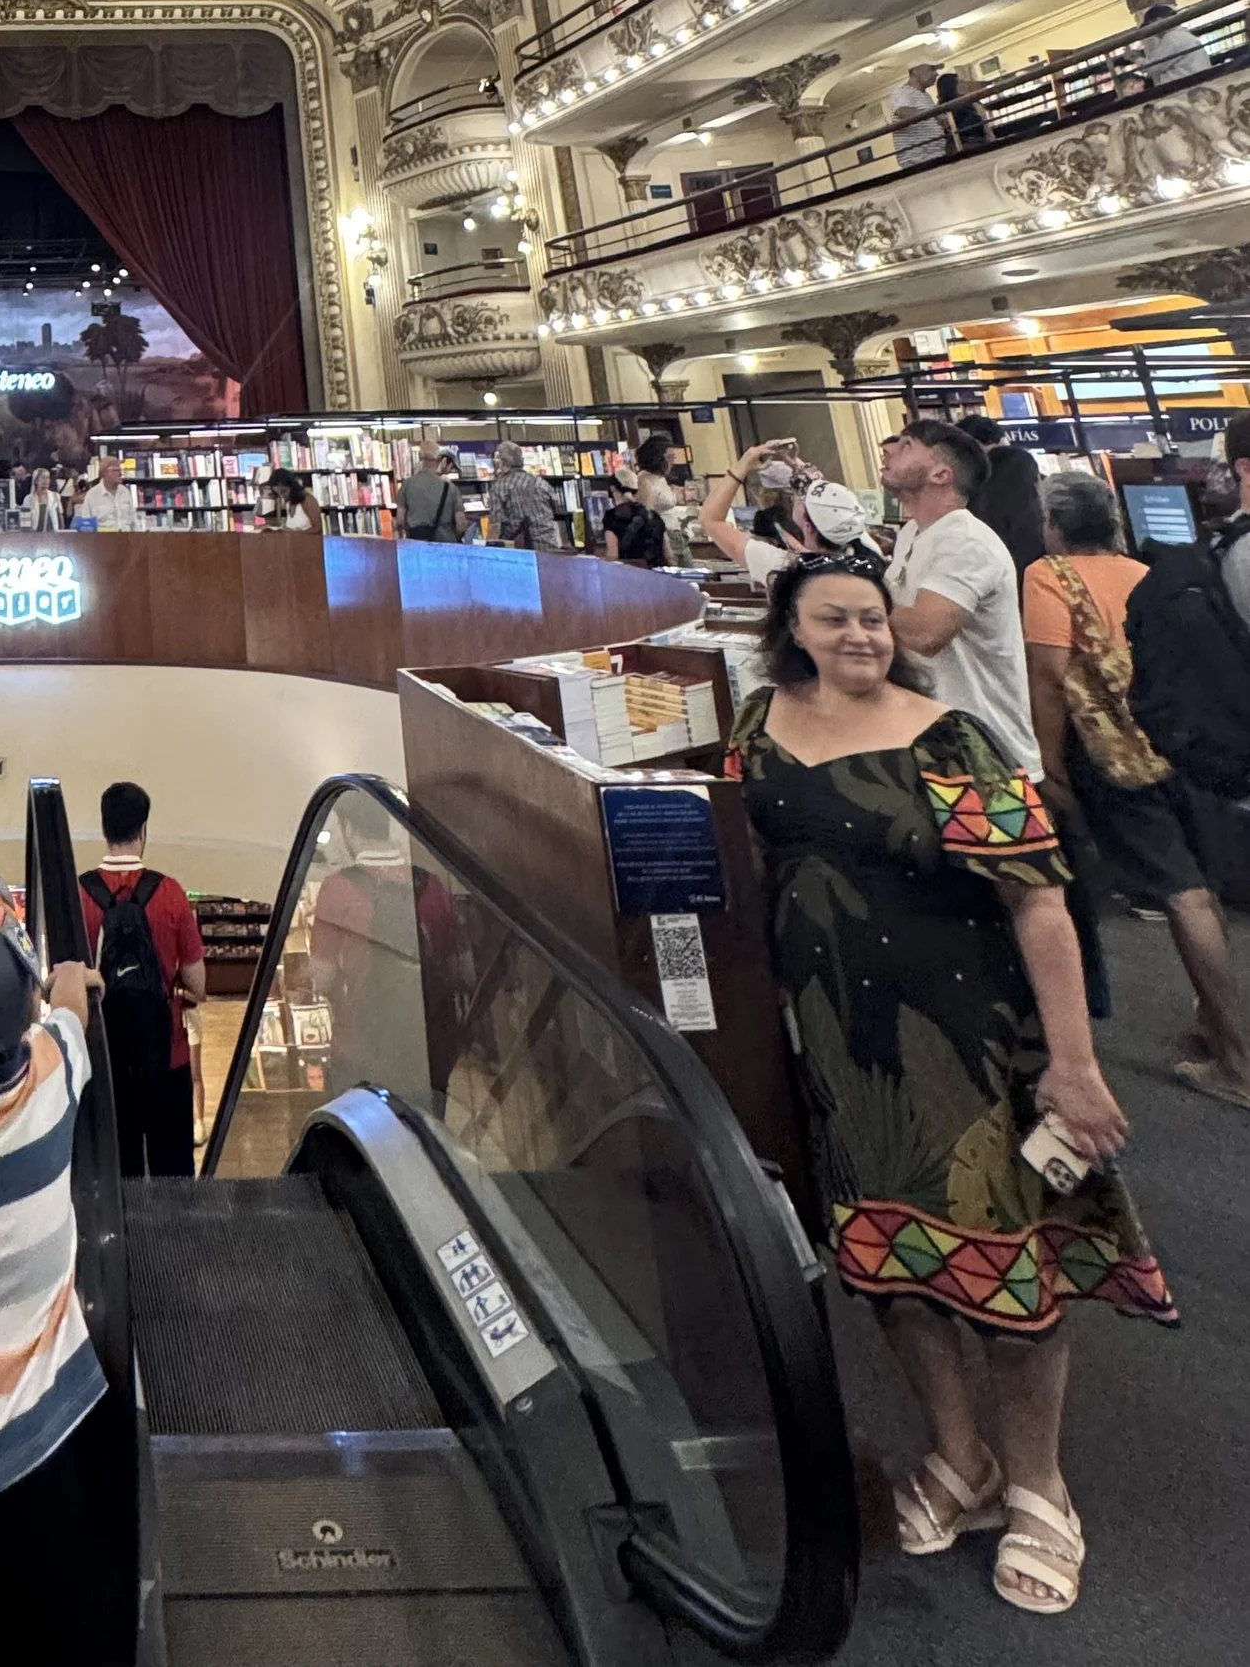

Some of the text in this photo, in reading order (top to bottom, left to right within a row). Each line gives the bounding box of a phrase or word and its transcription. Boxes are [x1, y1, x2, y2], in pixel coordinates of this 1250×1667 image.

[1189, 417, 1233, 431] POLI
[1004, 427, 1039, 442] AFÍAS
[278, 1549, 392, 1570] Schindler
